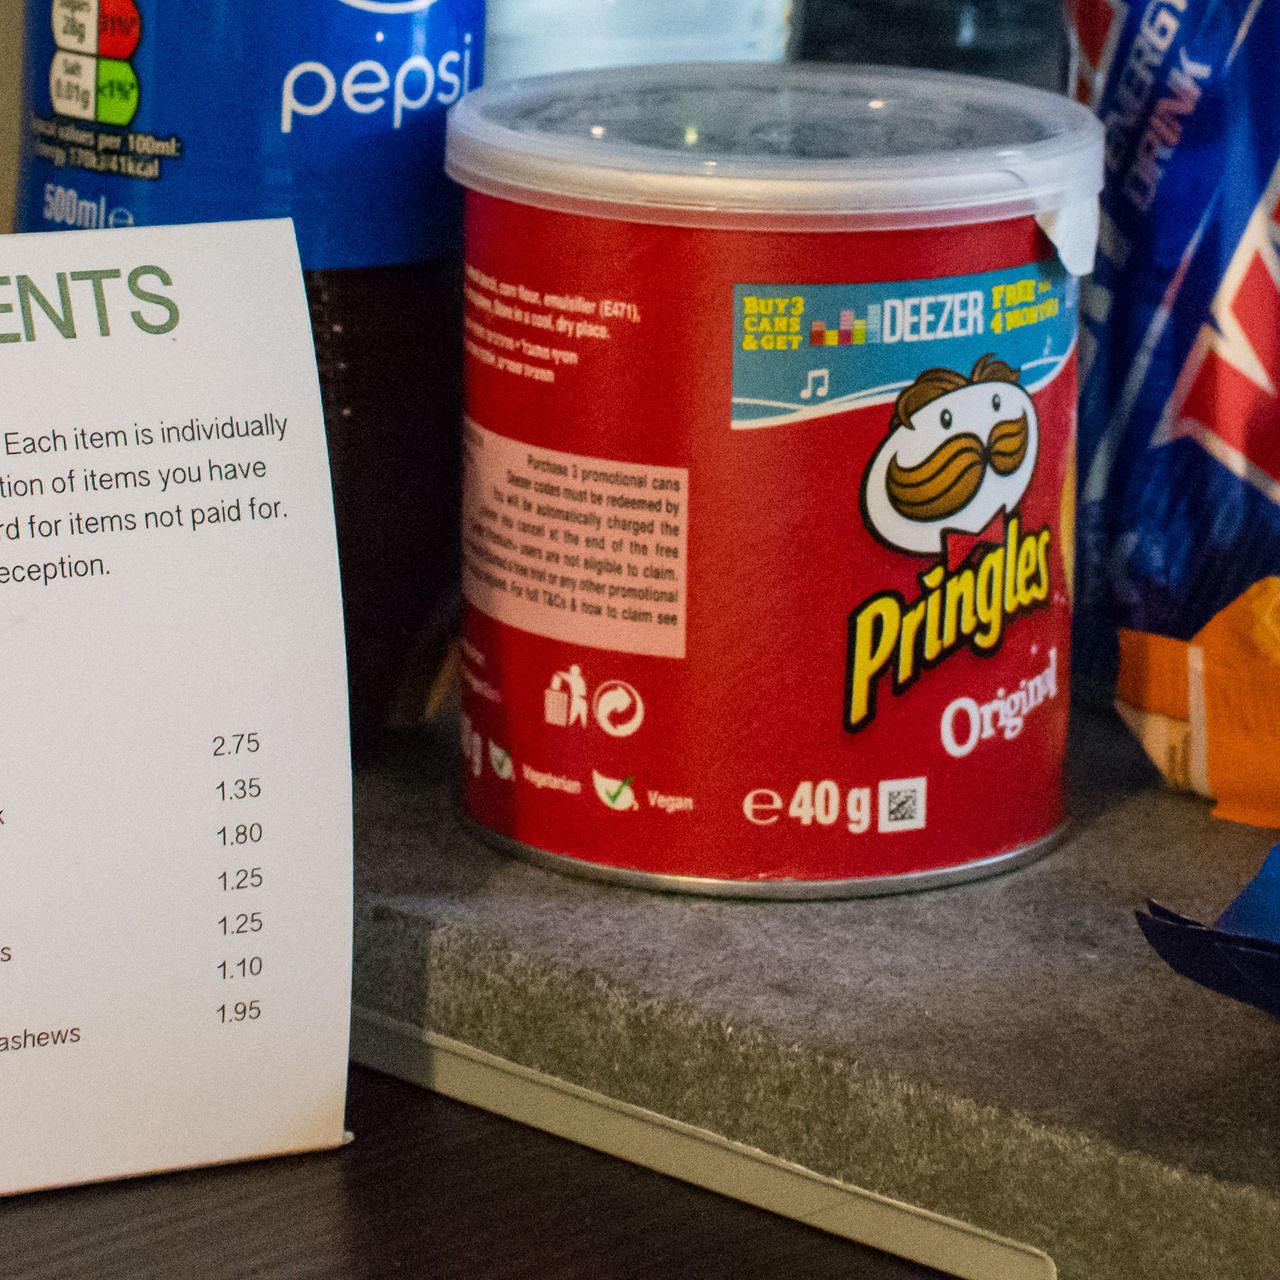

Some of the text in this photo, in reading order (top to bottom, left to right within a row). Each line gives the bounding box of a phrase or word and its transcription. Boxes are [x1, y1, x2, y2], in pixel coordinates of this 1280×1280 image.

[281, 32, 472, 134] pepsi
[1122, 46, 1213, 210] DRINK
[991, 279, 1036, 310] FREE
[743, 315, 801, 333] CANS
[882, 290, 984, 344] DEEZER
[990, 310, 1003, 335] 4
[3, 428, 68, 456] Each
[73, 426, 129, 451] item
[133, 422, 155, 446] is
[160, 412, 288, 444] individually
[50, 468, 76, 495] of
[83, 468, 152, 492] items
[157, 465, 203, 493] you
[207, 458, 267, 482] have
[27, 513, 63, 539] for
[68, 511, 138, 536] items
[143, 504, 185, 530] not
[190, 497, 242, 532] paid
[247, 496, 288, 521] for.
[846, 514, 1052, 730] Pringles
[940, 645, 1058, 758] Original
[212, 731, 261, 758] 2.75
[215, 777, 262, 802] 1.35
[646, 789, 695, 814] Vegan
[788, 779, 871, 834] 40 g
[216, 822, 263, 847] 1.80
[217, 866, 264, 892] 1.25
[217, 911, 264, 936] 1.25
[216, 955, 263, 981] 1.10
[216, 999, 262, 1024] 1.95
